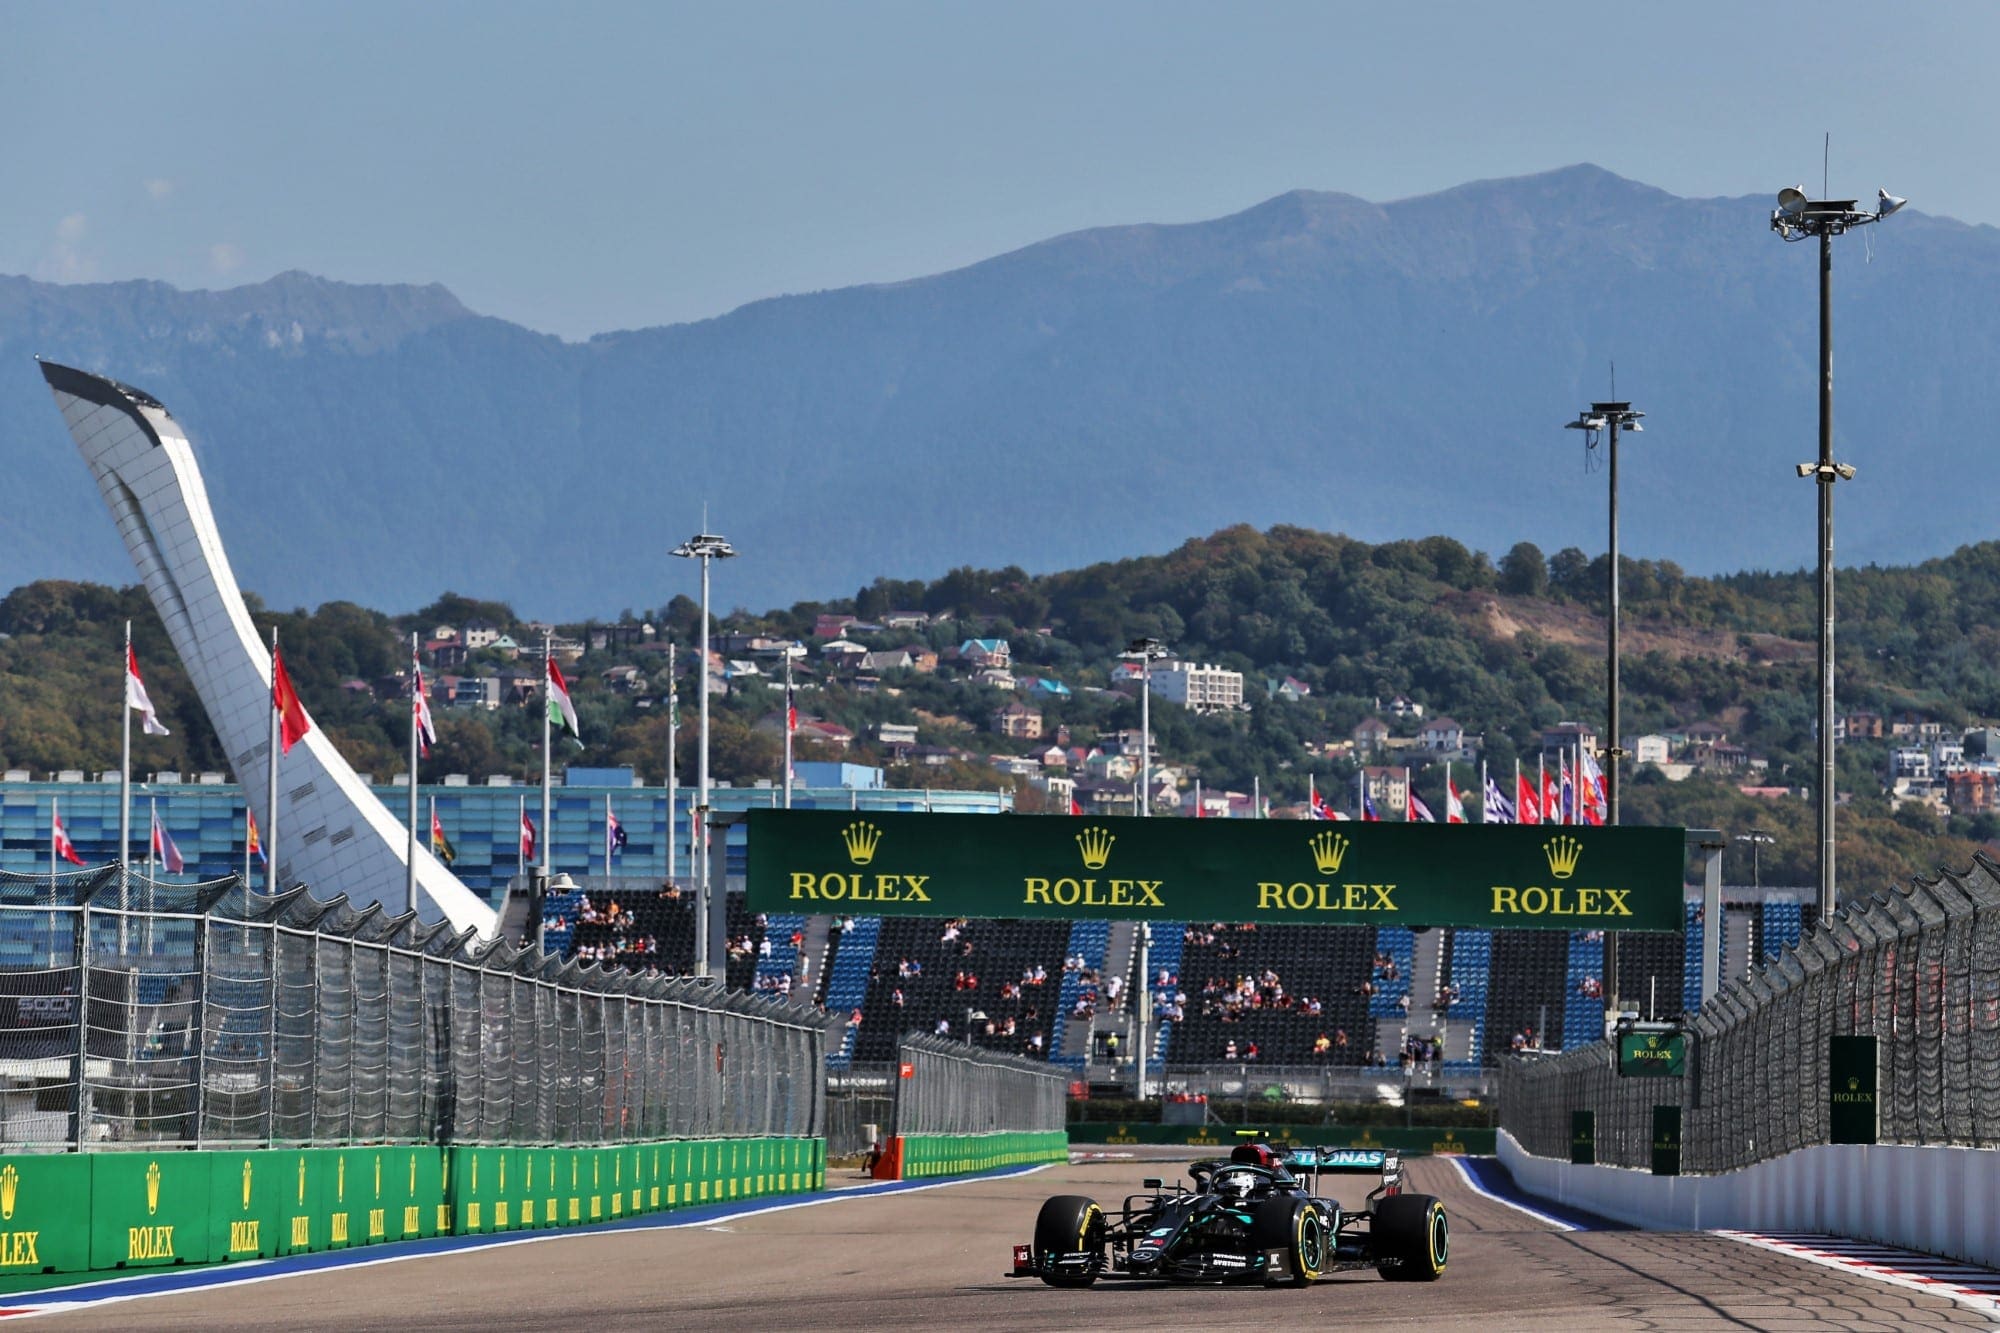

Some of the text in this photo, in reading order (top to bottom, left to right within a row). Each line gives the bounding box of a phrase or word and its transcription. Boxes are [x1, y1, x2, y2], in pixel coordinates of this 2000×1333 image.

[790, 872, 930, 902] ROLEX
[1024, 877, 1165, 907] ROLEX
[1257, 882, 1398, 911] ROLEX
[1491, 886, 1632, 916] ROLEX
[1633, 1050, 1671, 1059] ROLEX
[1834, 1093, 1872, 1102] ROLEX
[0, 1231, 39, 1266] LEX
[128, 1225, 174, 1260] ROLEX
[231, 1220, 259, 1253] ROLEX
